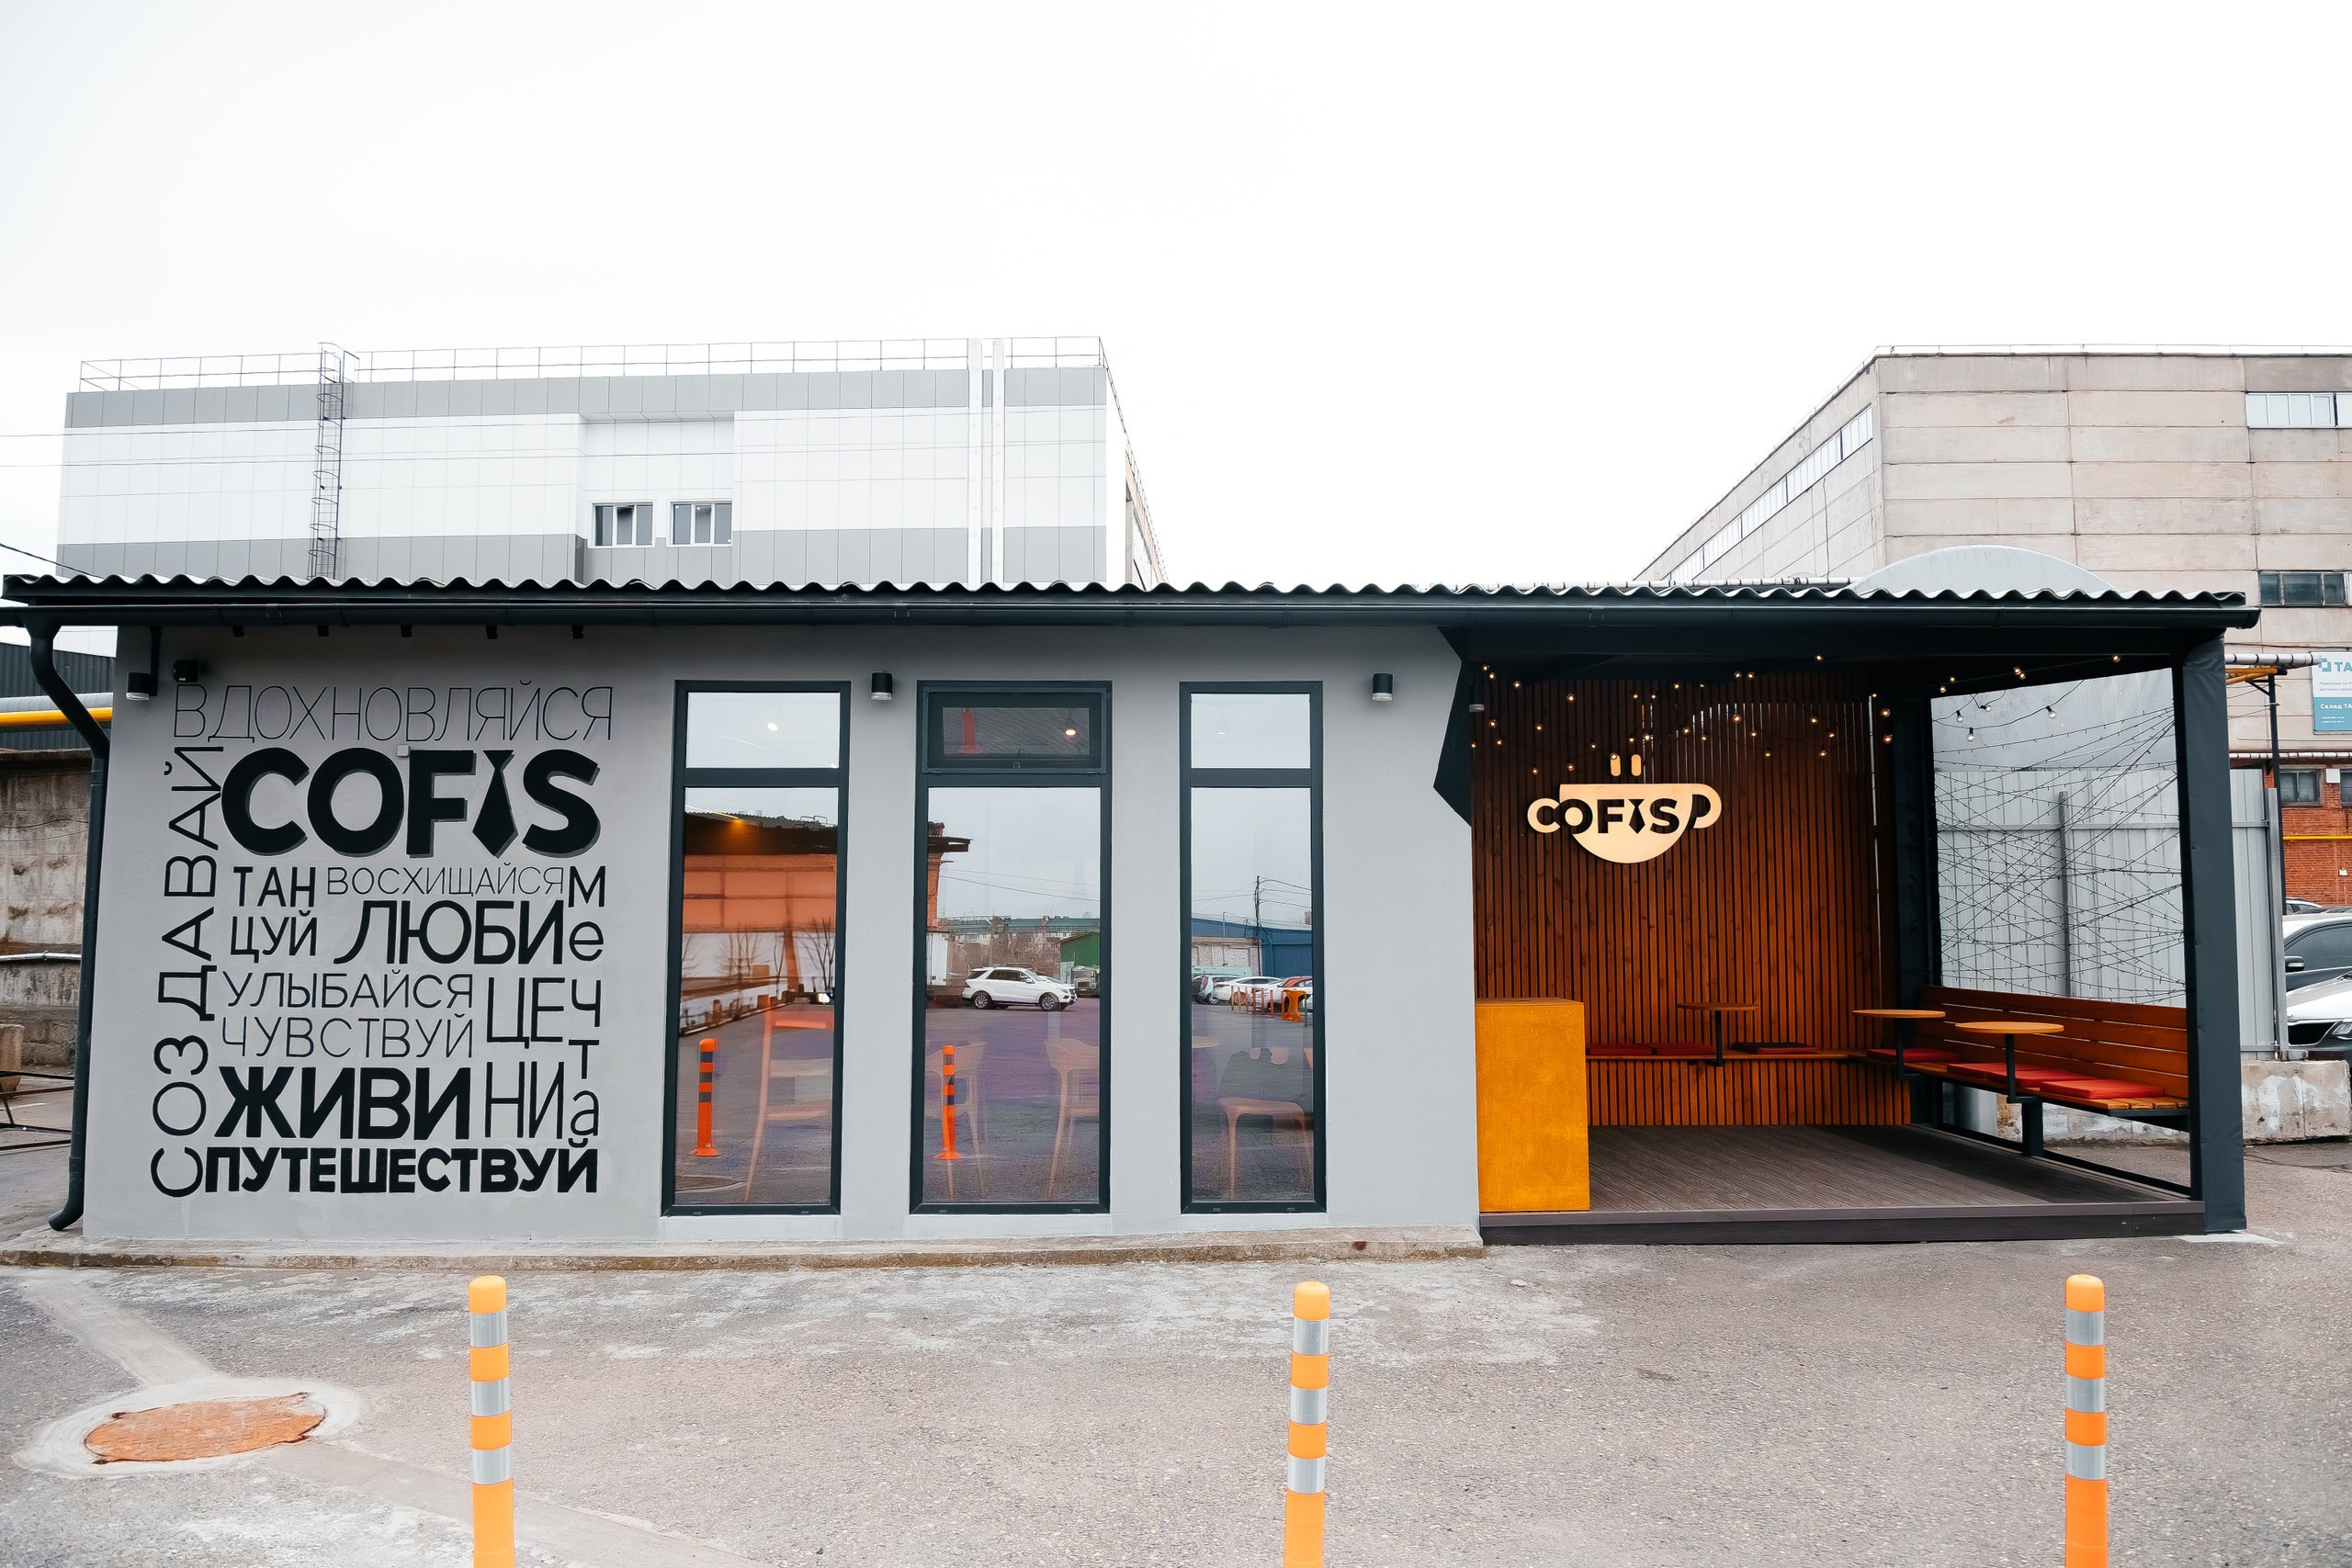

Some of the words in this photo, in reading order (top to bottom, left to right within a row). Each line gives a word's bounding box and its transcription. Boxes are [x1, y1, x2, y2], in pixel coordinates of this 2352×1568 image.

[171, 680, 613, 742] ВДОХНОВЛЯЙСЯ
[327, 863, 564, 897] ВОСХИЩАЙСЯ
[334, 899, 564, 964] ЛЮБИ
[222, 970, 473, 1009] УЛЫБАЙСЯ
[221, 1012, 473, 1058] ЧУВСТВУЙ
[214, 1066, 471, 1140] ЖИВИ
[205, 1138, 598, 1193] ПУТЕШЕСТВУЙ
